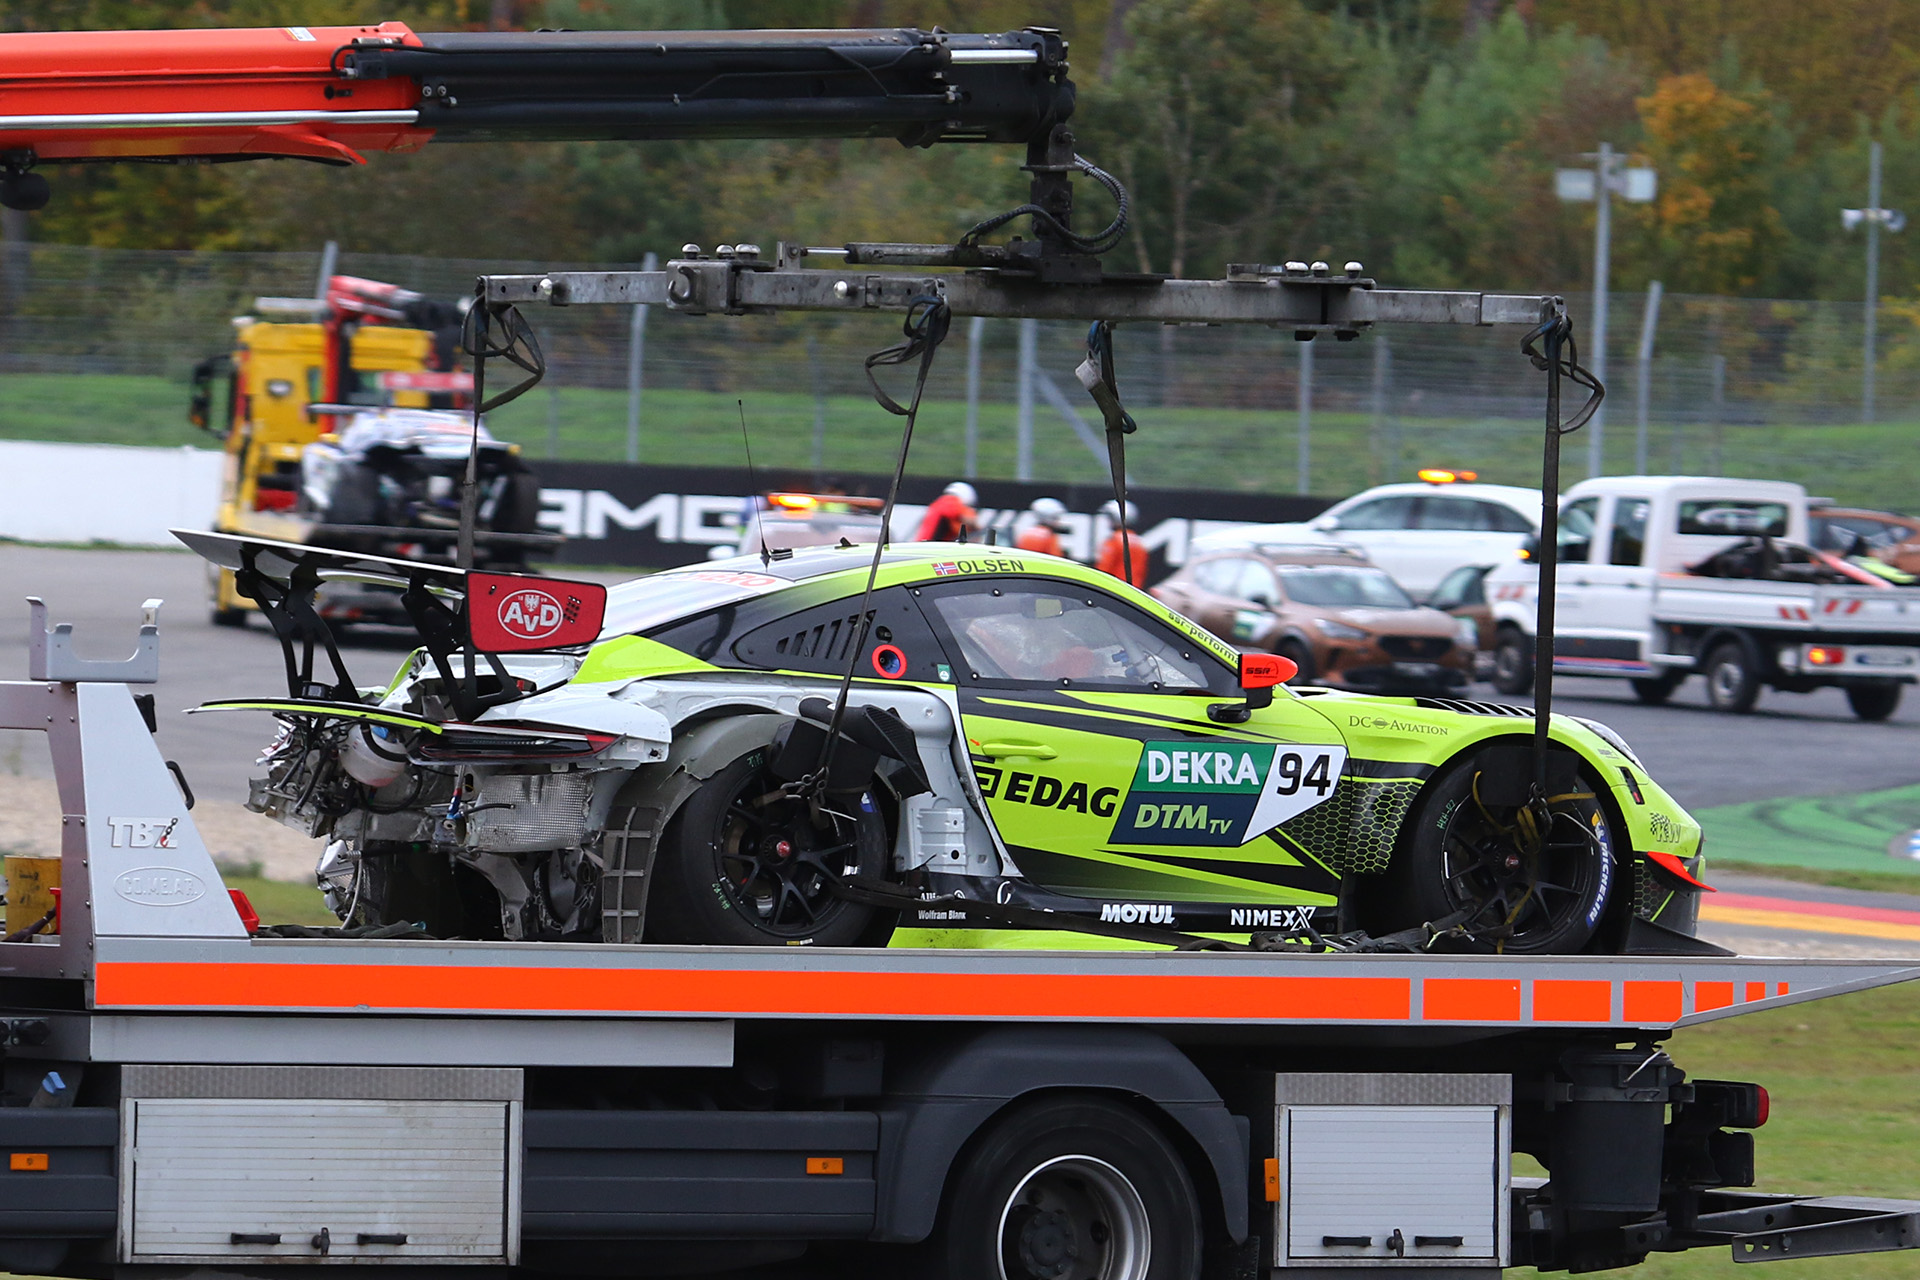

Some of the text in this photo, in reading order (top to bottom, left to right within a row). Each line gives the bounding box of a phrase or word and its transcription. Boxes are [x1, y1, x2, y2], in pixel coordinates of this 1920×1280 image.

[957, 560, 1025, 574] OLSEN
[1349, 715, 1371, 728] DC
[1148, 751, 1260, 785] DEKRA
[1276, 753, 1331, 797] 94
[1004, 771, 1120, 818] EDAG
[1134, 804, 1209, 830] DTM
[107, 816, 179, 849] TBZ
[1589, 842, 1611, 922] MICHELIN
[918, 909, 948, 920] Wolfram
[1100, 904, 1175, 924] MOTUL
